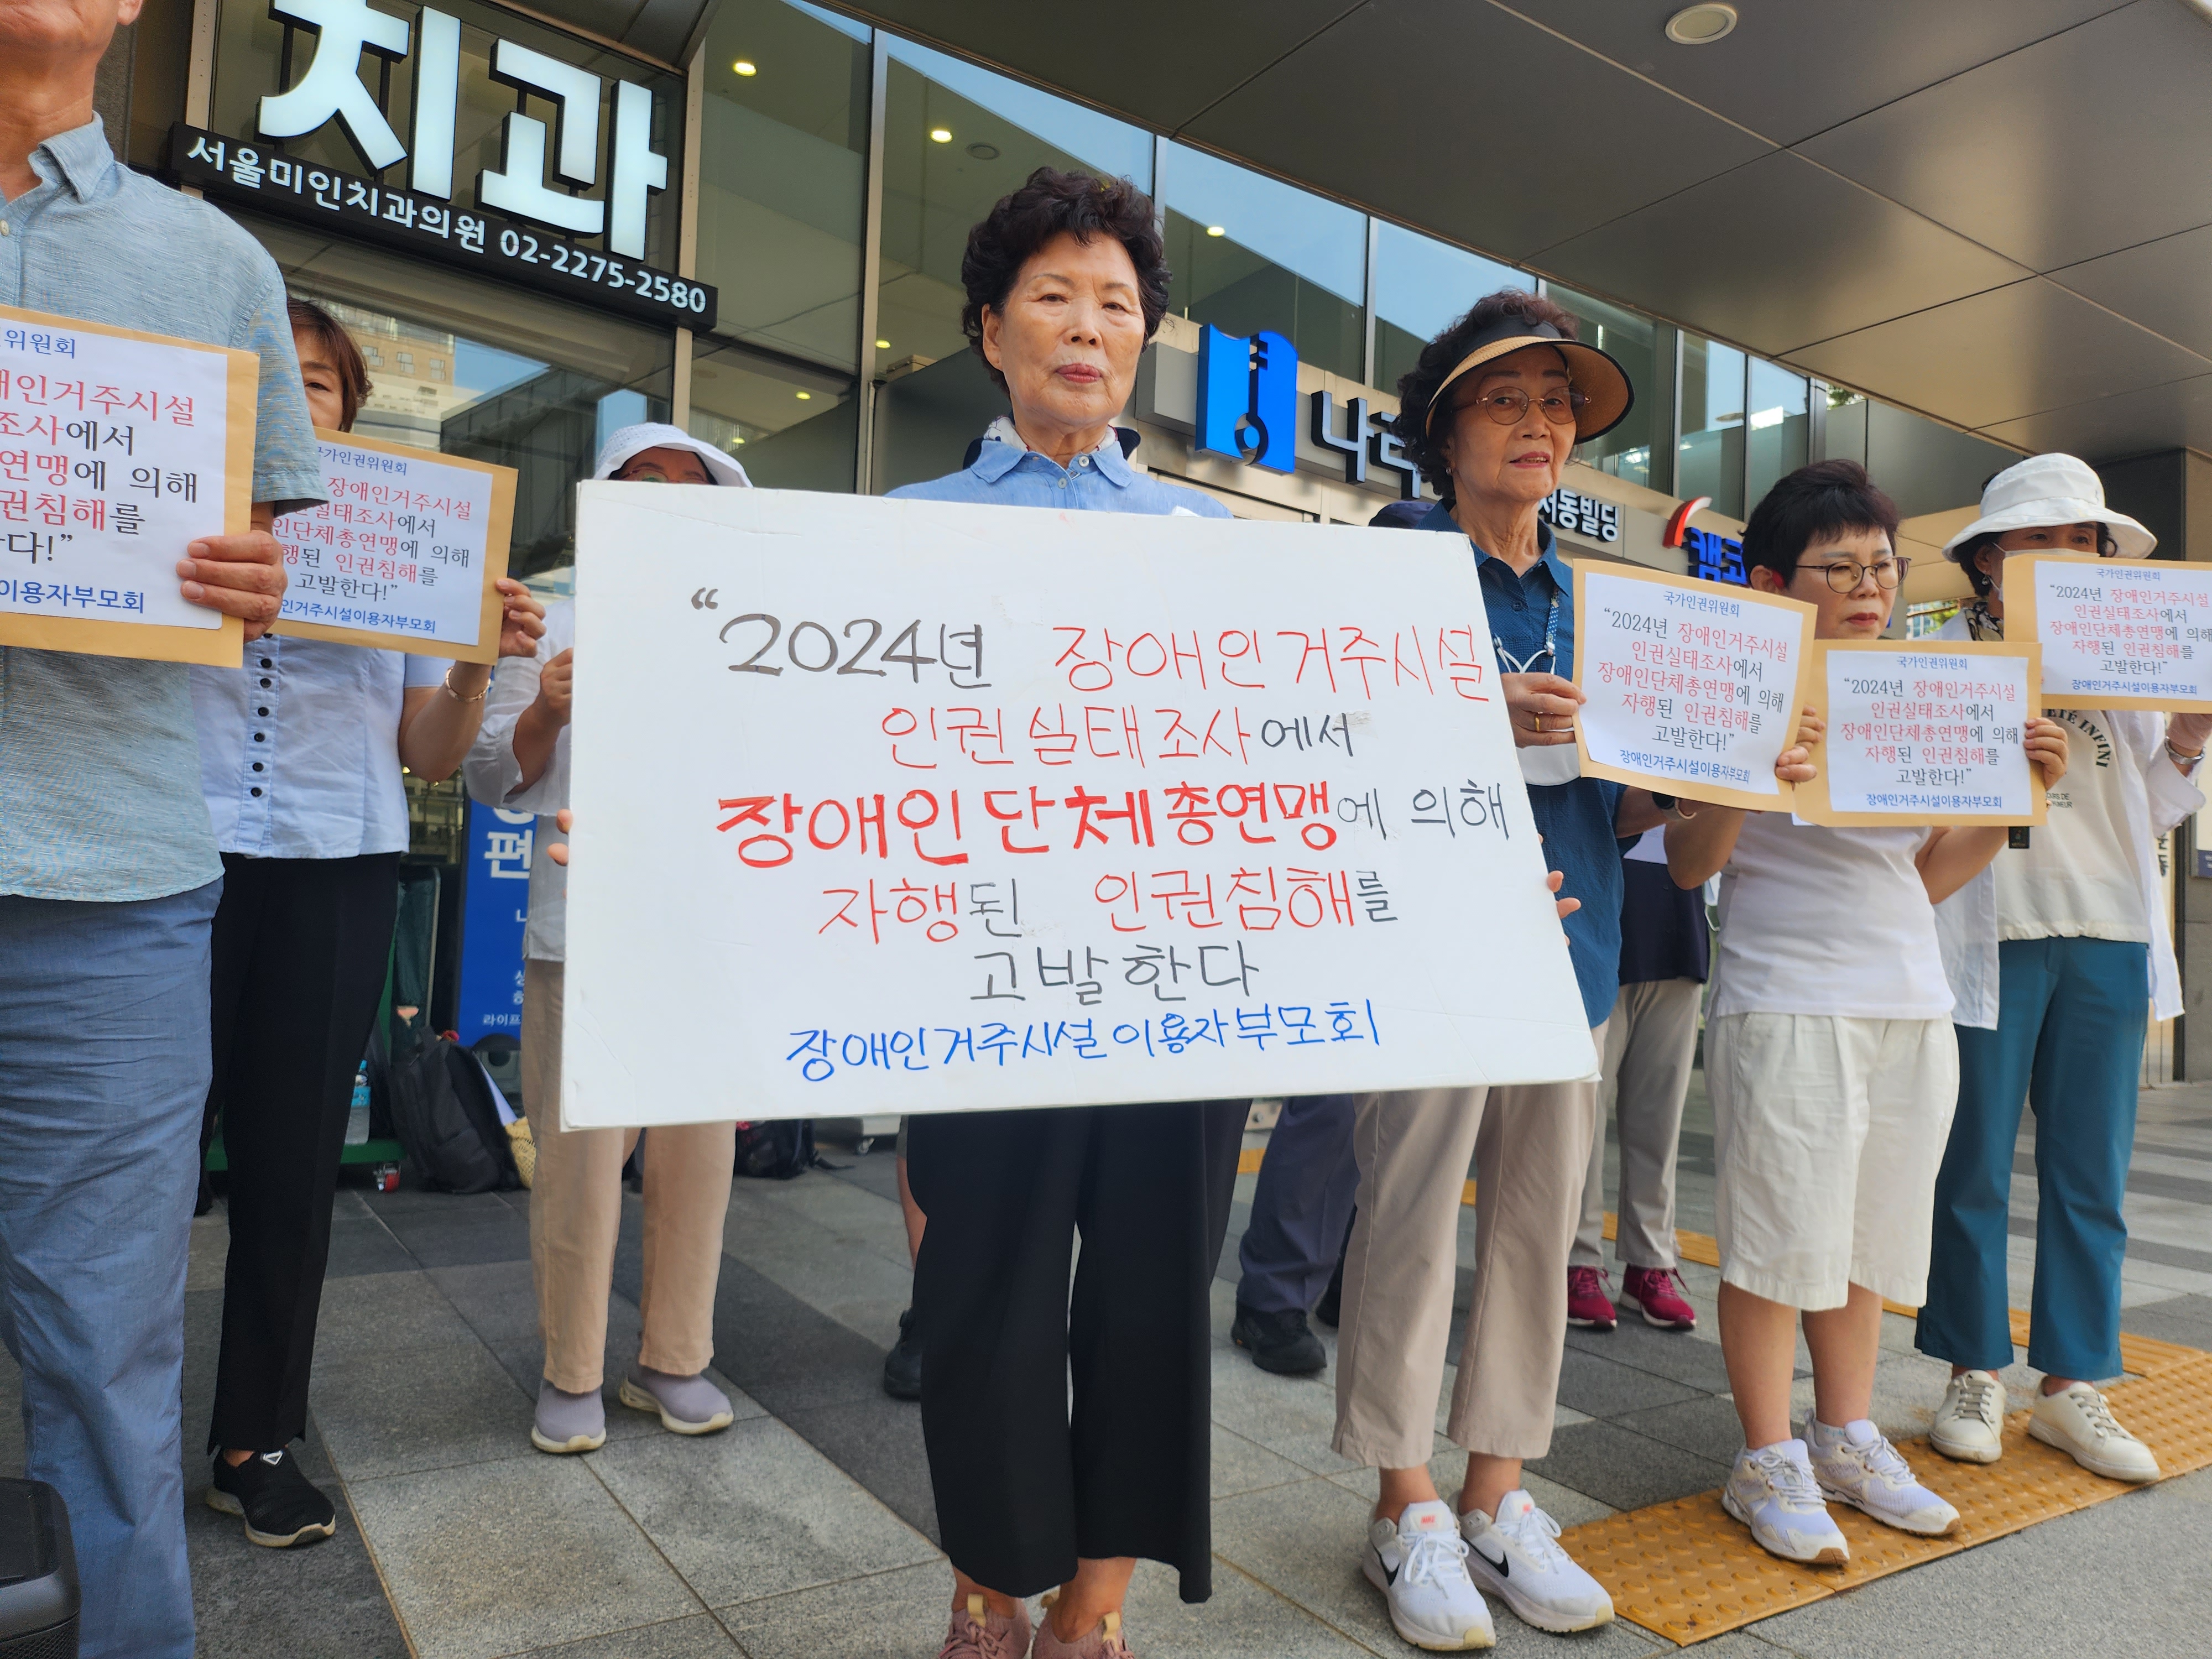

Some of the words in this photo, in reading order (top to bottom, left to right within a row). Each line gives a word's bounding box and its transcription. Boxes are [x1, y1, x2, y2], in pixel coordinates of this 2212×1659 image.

[258, 0, 667, 261] 치과
[188, 136, 486, 254] 서울미인치과의원
[499, 228, 707, 314] 02-2275-2580
[129, 466, 197, 504] 의해
[327, 477, 471, 521] 장애인거주시설
[295, 502, 436, 539] 실태조사에서
[0, 531, 74, 565] 다!”
[272, 518, 418, 560] 인단체총연맹에
[431, 545, 469, 568] 의해
[336, 554, 438, 587] 인권침해를
[2096, 568, 2161, 581] 국가인권위원회
[1663, 591, 1739, 618] 국가인권위원회
[2074, 604, 2188, 624] 인권실태조사에서
[2110, 588, 2210, 608] 장애인거주시설
[1677, 623, 1788, 662] 장애인거주시설
[2049, 620, 2178, 641] 장애인단체총연맹에
[2186, 628, 2212, 643] 의해
[2073, 639, 2115, 656] 자행된
[2123, 642, 2195, 660] 인권침해를
[1052, 624, 1489, 702] 장애인거주시설
[1632, 640, 1762, 682] 인권실태조사에서
[1896, 656, 1968, 670] 국가인권위원회
[1598, 662, 1750, 706] 장애인단체총연맹에
[1757, 690, 1784, 714] 의해
[1912, 680, 2016, 702] 장애인거주시설
[2072, 679, 2198, 696] 장애인거주시설이용자부모회
[1621, 693, 1673, 719] 자행된
[1684, 703, 1762, 735] 인권침해를
[1871, 701, 1994, 722] 인권실태조사에서
[882, 704, 1354, 769] 인권실태조사에서
[1840, 722, 1983, 743] 장애인단체총연맹에
[1992, 727, 2018, 744] 의해
[2078, 719, 2111, 768] INFINI
[1620, 749, 1750, 785] 장애인거주시설이용자부모회
[1865, 745, 1912, 764] 자행된
[1922, 747, 2000, 766] 인권침해를
[1866, 794, 2002, 808] 장애인거주시설이용자부모회
[717, 781, 1386, 868] 장애인단체총연맹에
[1411, 779, 1509, 841] 의해
[818, 877, 1022, 945] 자행된
[1094, 867, 1399, 933] 인권침해를
[970, 940, 1259, 1004] 고발한다
[787, 1000, 1380, 1082] 장애인거주시설이용자부모회
